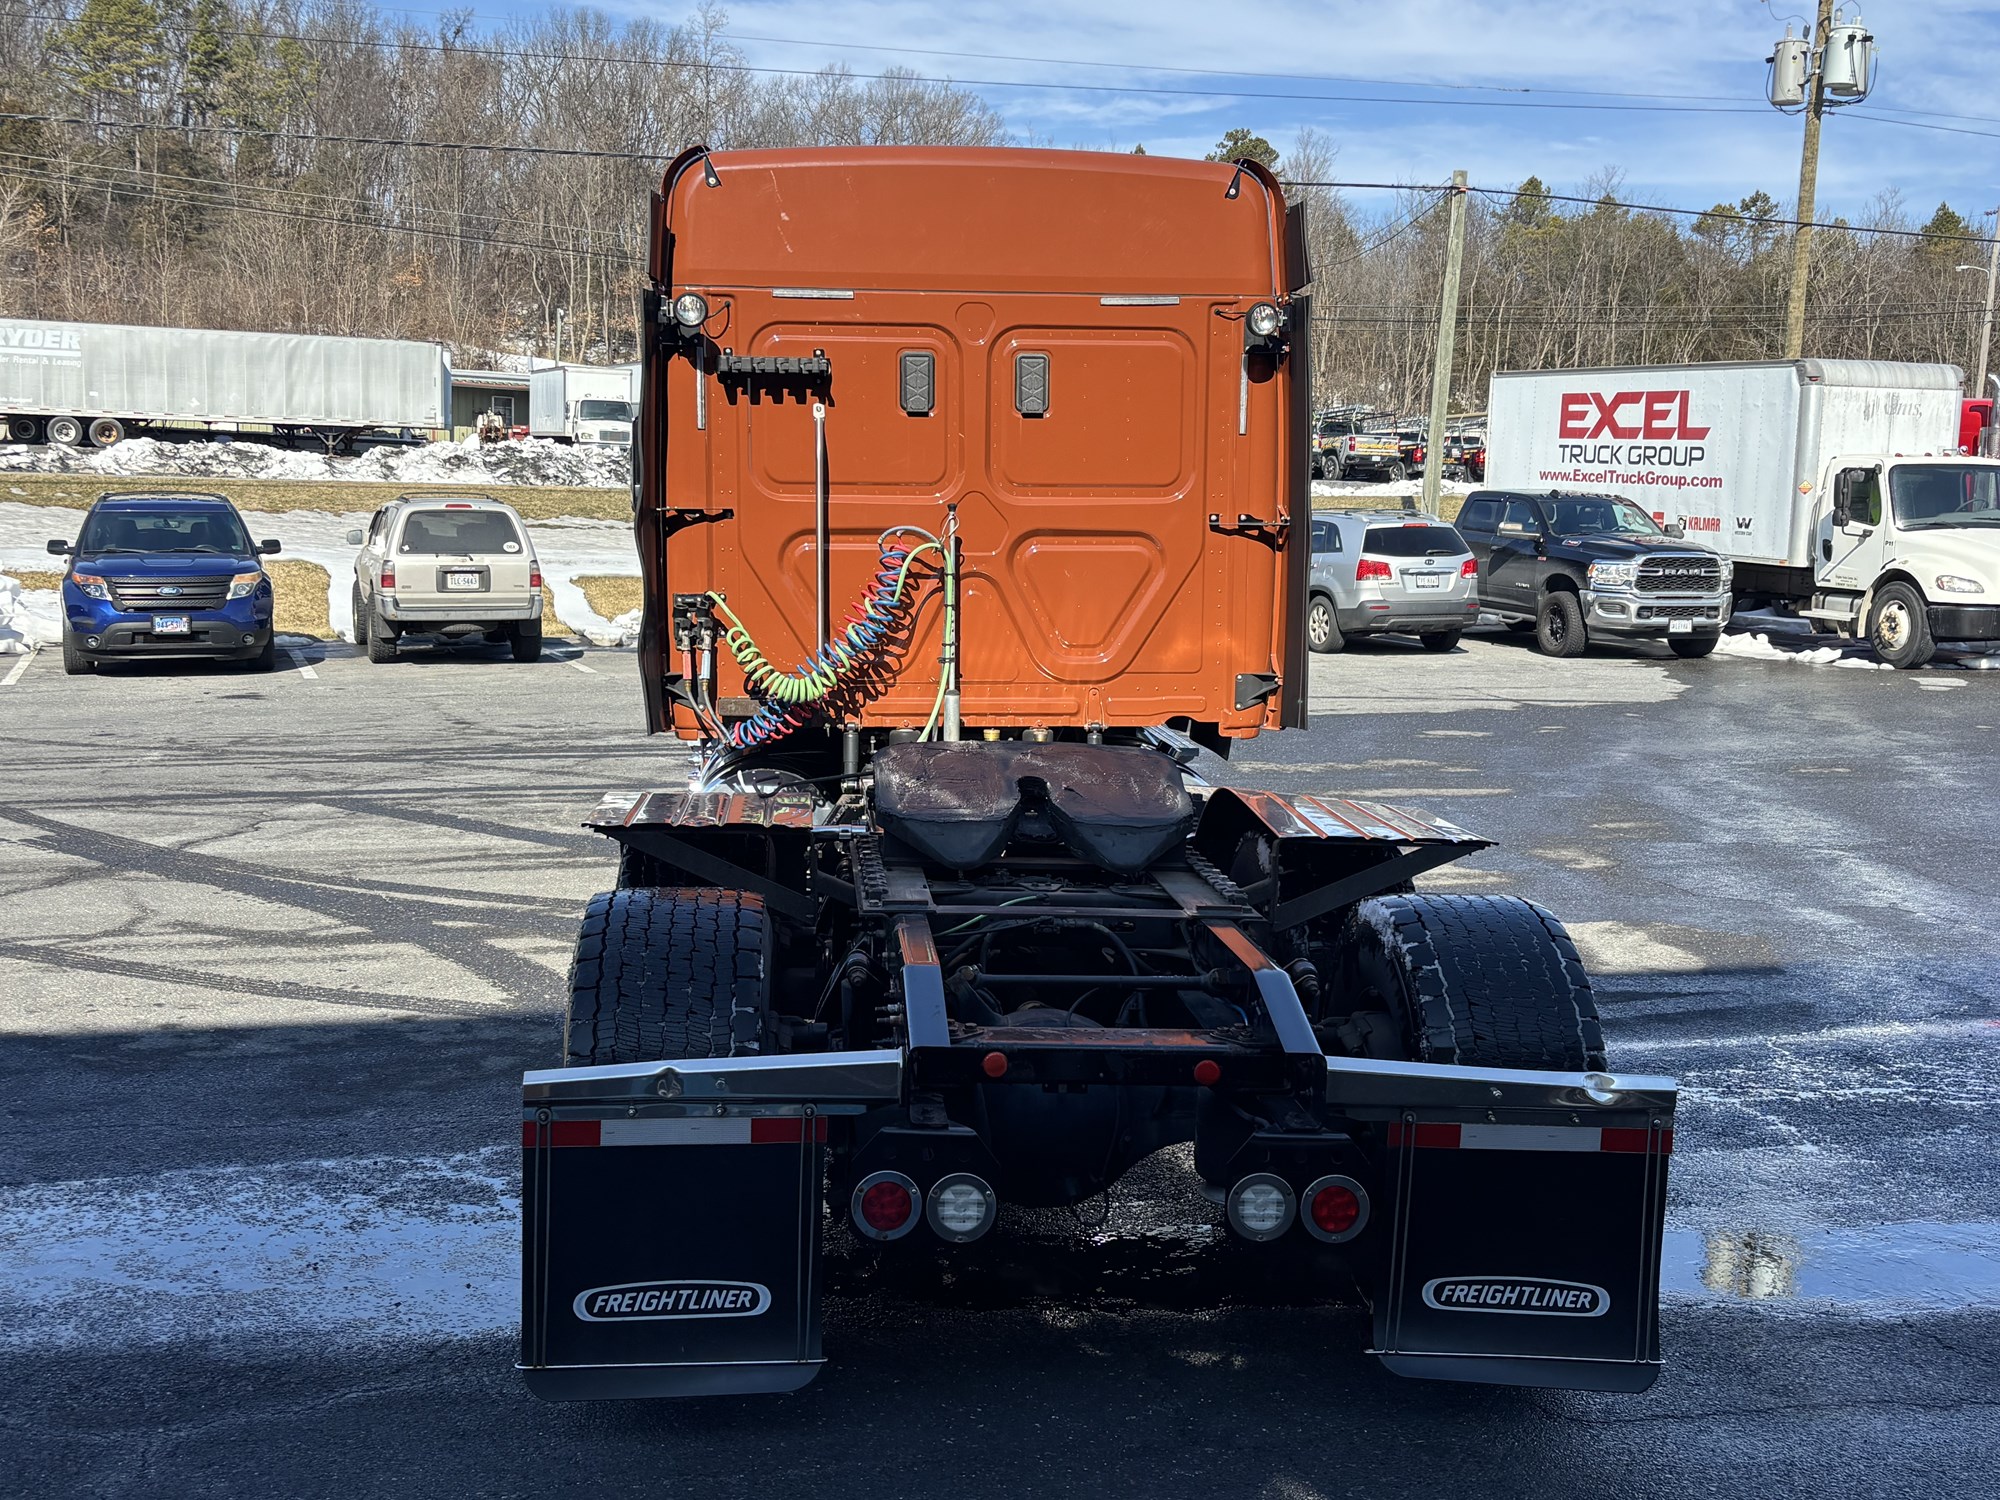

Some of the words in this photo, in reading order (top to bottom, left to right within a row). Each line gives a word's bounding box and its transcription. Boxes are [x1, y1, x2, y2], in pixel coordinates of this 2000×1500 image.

[1559, 390, 1712, 440] EXCEL
[1559, 444, 1623, 465] TRUCK
[1627, 446, 1705, 467] GROUP
[1539, 469, 1723, 489] www.ExcelTruckGroup.com
[1688, 516, 1721, 532] KALMAR
[592, 1289, 754, 1314] FREIGHTLINER
[1440, 1284, 1593, 1309] FREIGHTLINER
